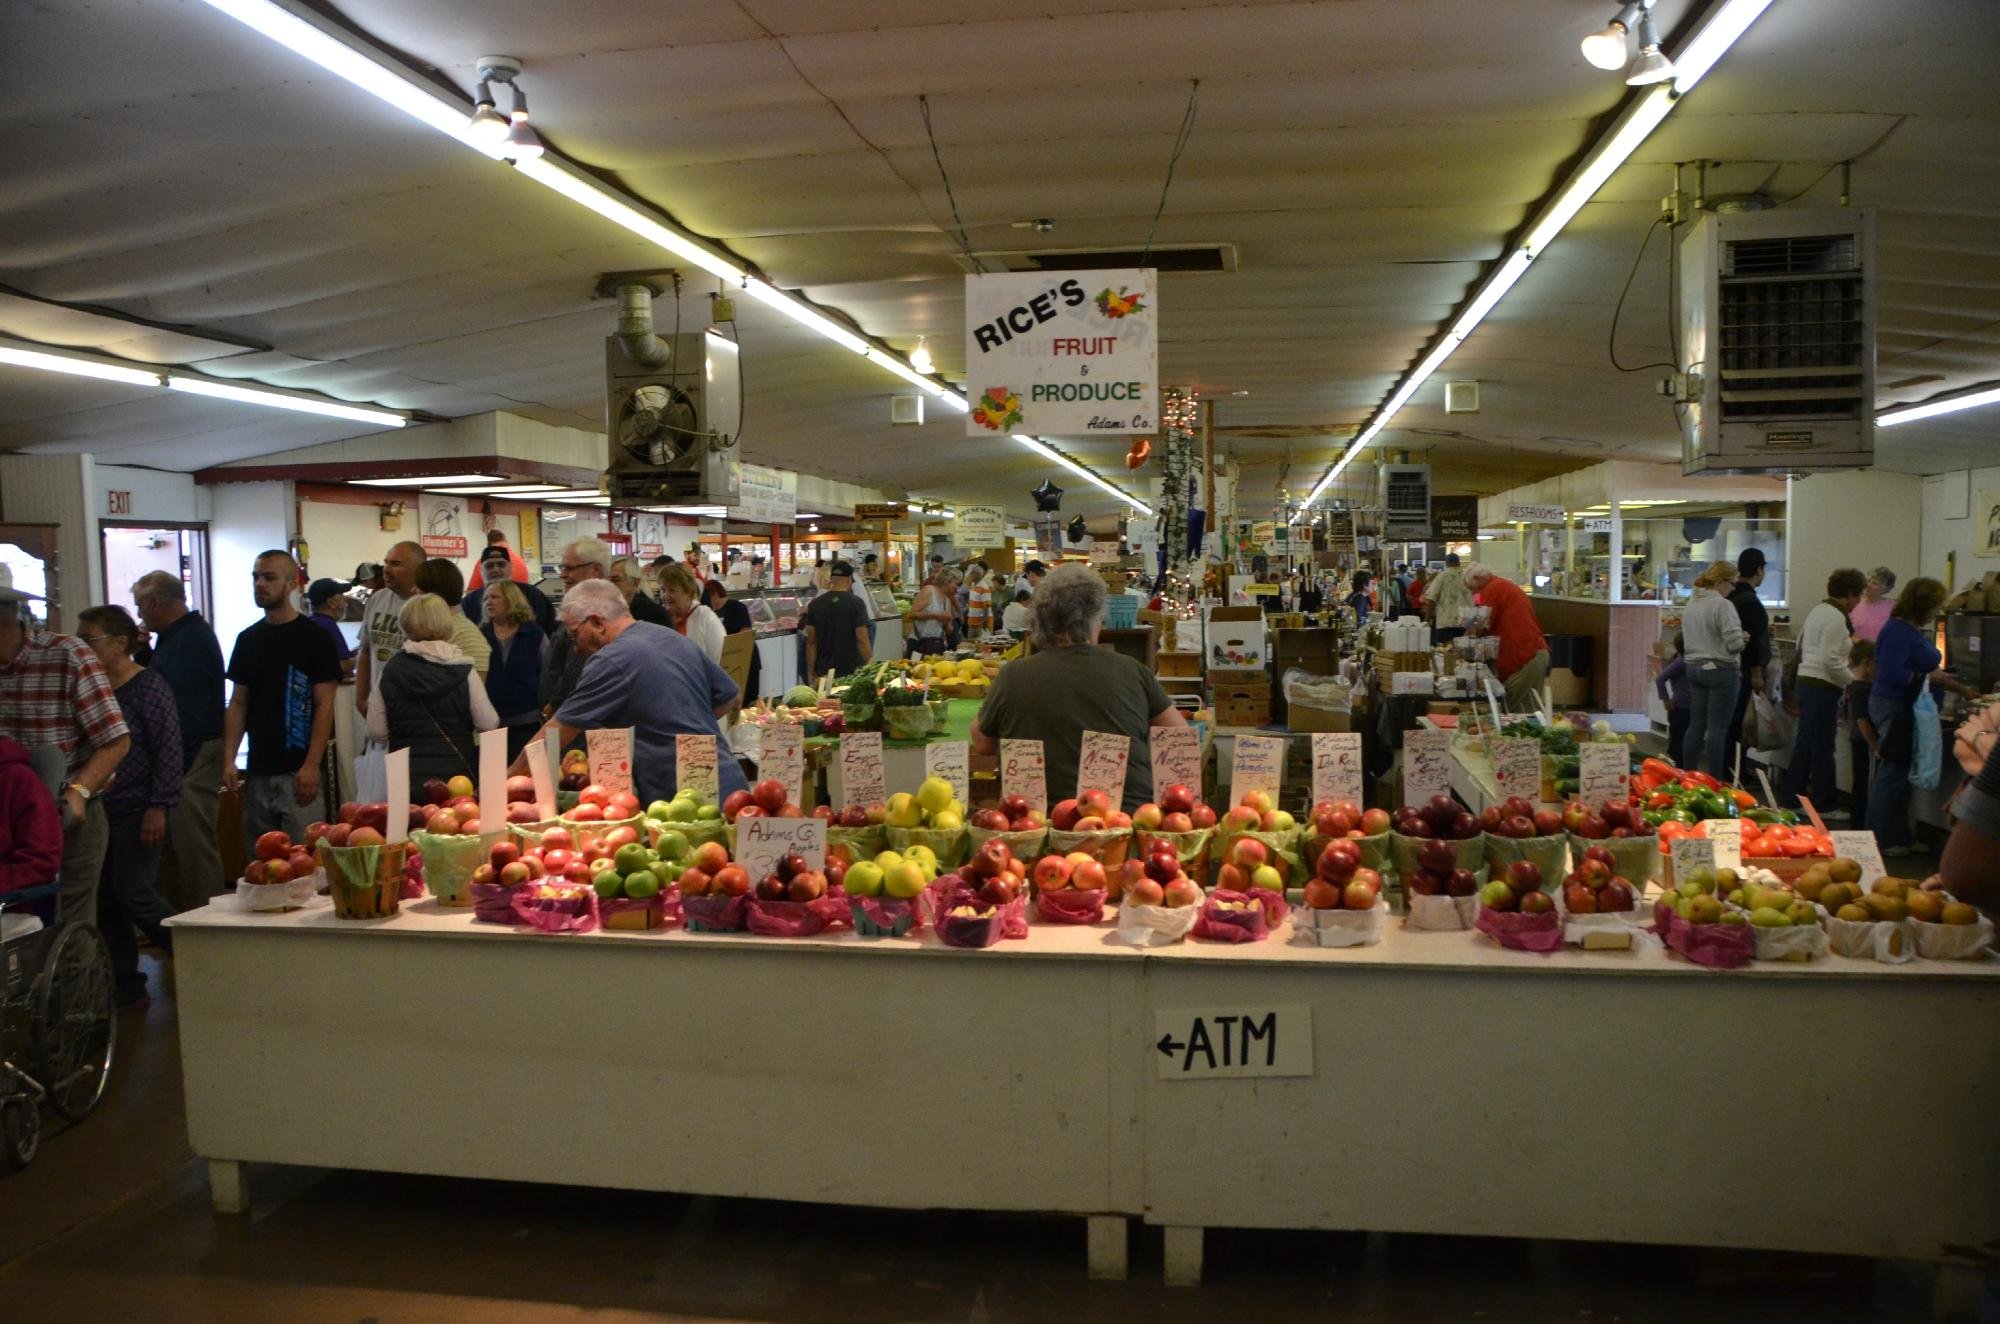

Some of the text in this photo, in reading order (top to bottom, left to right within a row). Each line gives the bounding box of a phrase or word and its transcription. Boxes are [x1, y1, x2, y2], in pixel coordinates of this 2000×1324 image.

[973, 278, 1086, 353] RICE'S
[1053, 336, 1118, 356] FRUIT
[1080, 364, 1089, 376] &
[1031, 381, 1142, 402] PRODUCE
[1087, 414, 1153, 429] Adams Co.
[109, 490, 131, 514] EXIT
[1441, 519, 1469, 527] bake
[1441, 528, 1469, 537] shop
[1593, 520, 1612, 531] ATM
[748, 821, 793, 842] Adams
[1183, 1012, 1277, 1071] ATM
